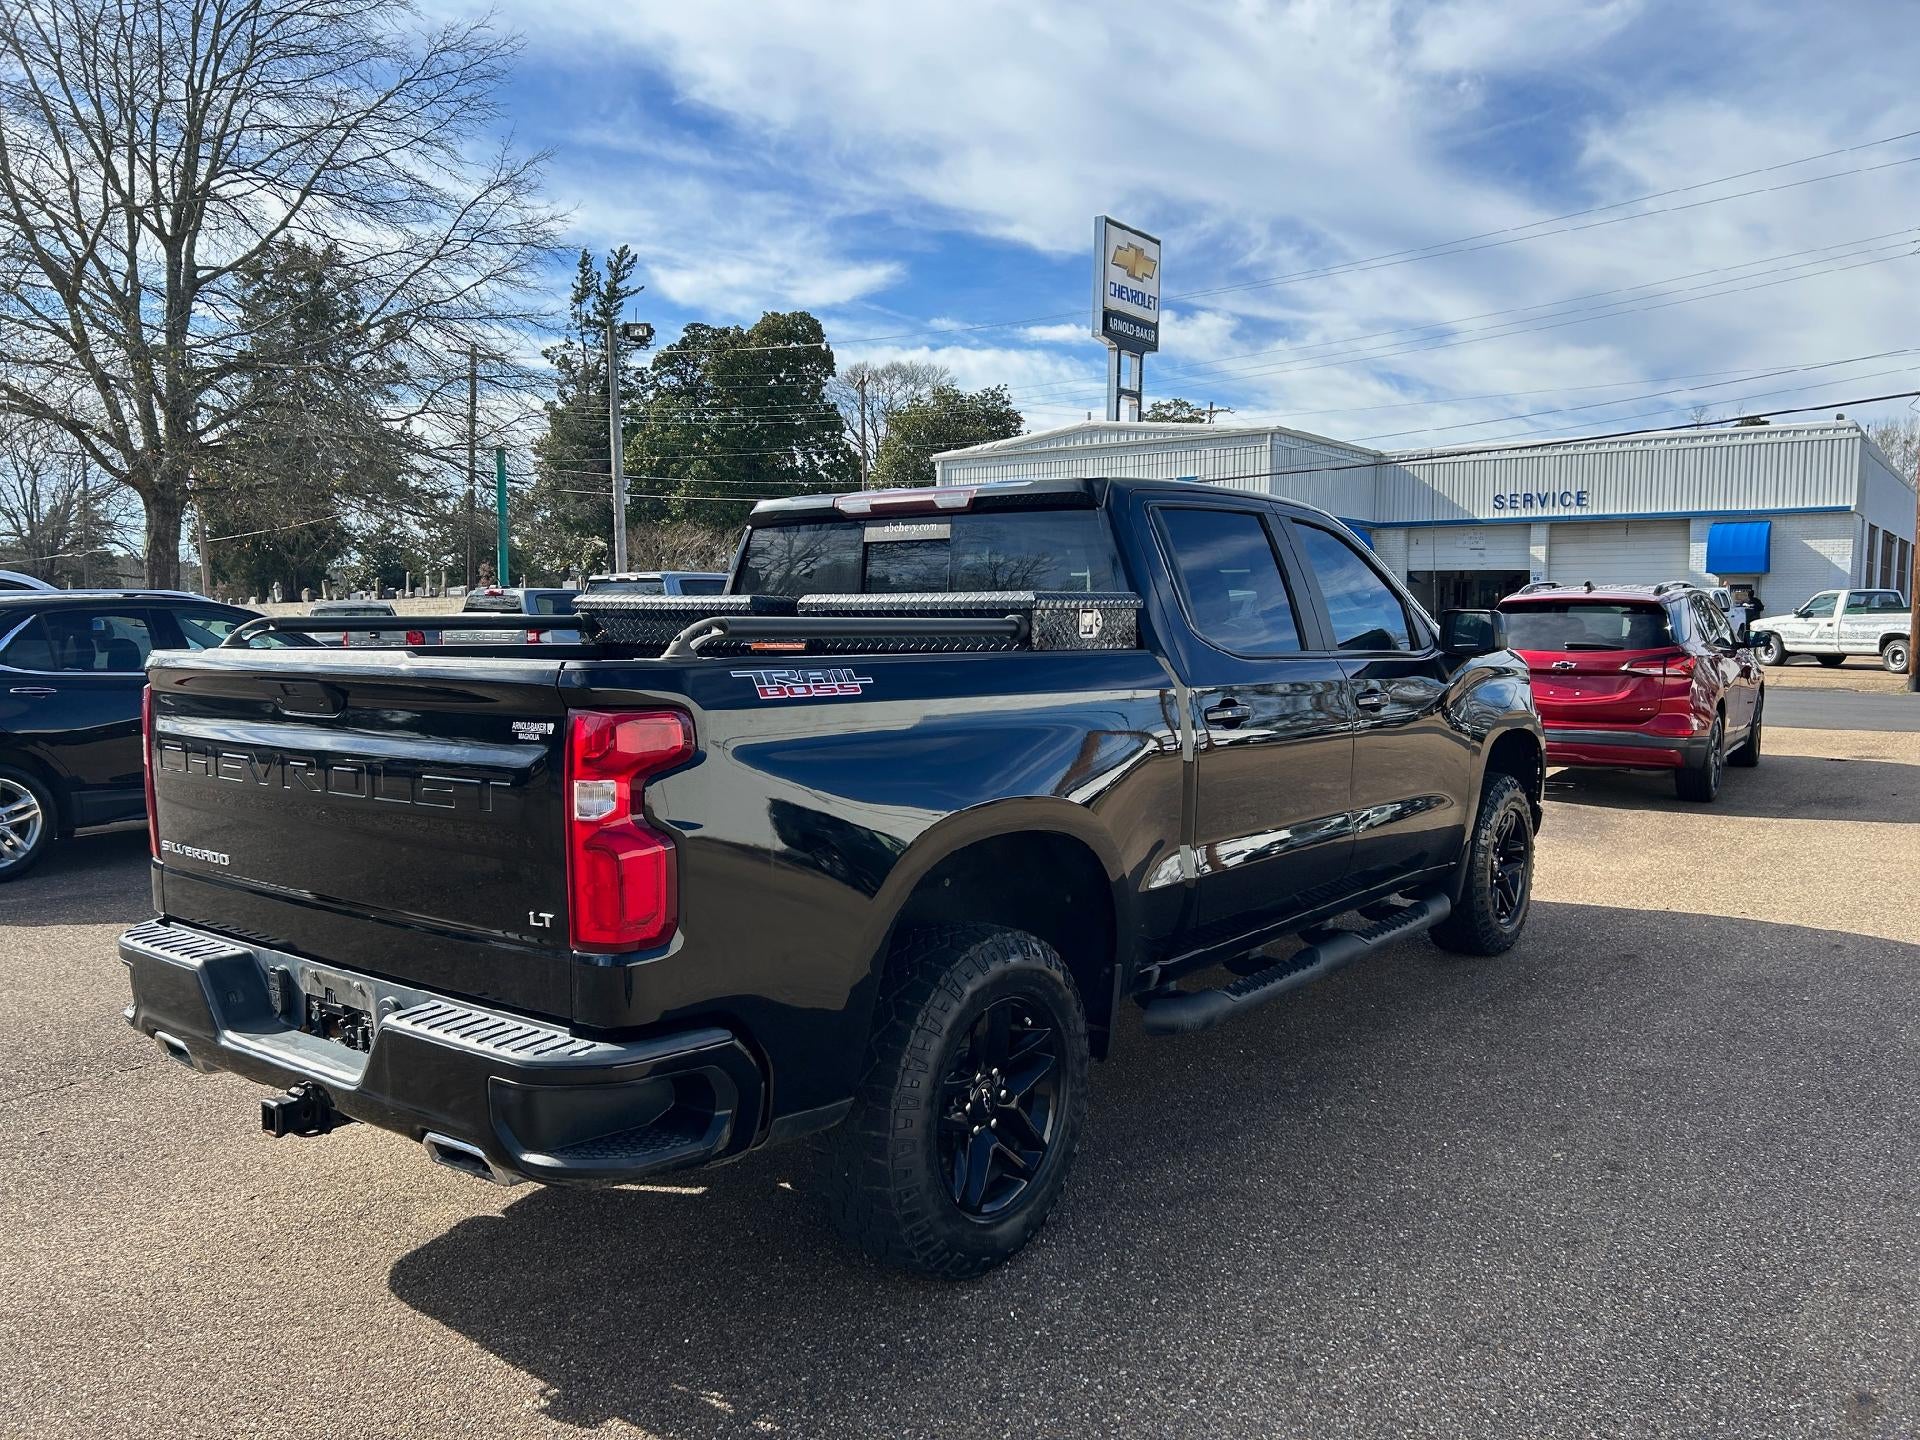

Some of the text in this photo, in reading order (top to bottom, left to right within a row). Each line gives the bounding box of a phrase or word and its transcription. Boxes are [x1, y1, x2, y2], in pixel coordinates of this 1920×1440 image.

[1109, 281, 1158, 311] CHEVROLET
[1109, 317, 1156, 342] ARNOLD-BAKER
[1493, 490, 1589, 510] SERVICE
[730, 668, 874, 687] TRAIL
[757, 682, 863, 699] BOSS
[518, 732, 540, 741] MAGNOLIA
[159, 738, 515, 813] CHEVROLET
[161, 839, 231, 866] SILVERADO
[528, 911, 555, 928] LT
